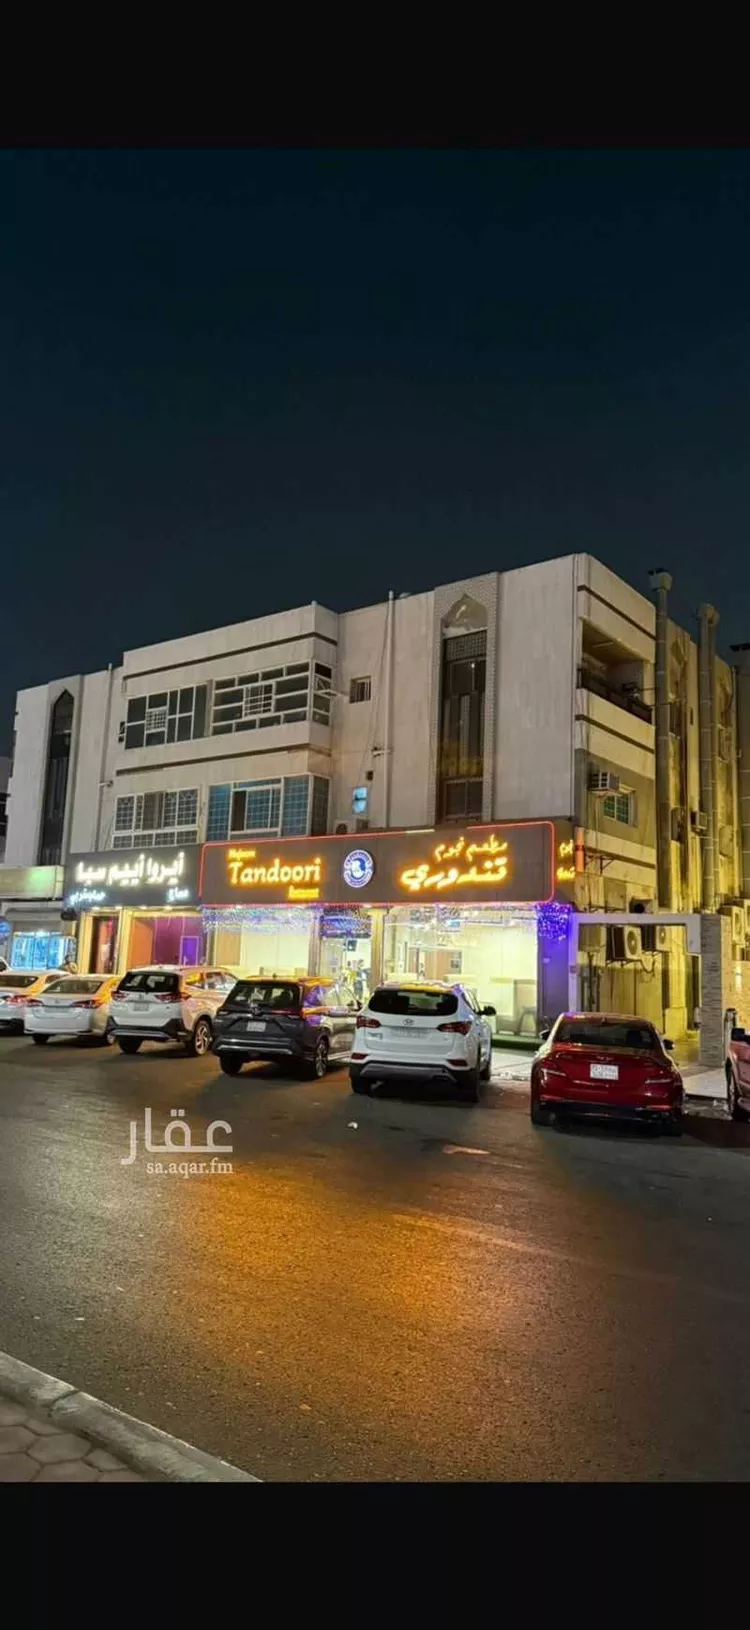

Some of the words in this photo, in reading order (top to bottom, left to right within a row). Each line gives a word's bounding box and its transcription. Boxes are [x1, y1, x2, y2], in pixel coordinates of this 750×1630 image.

[433, 836, 465, 863] نجوم
[466, 834, 508, 863] مطعم
[75, 860, 106, 887] سبا
[227, 856, 322, 885] Tandoori
[401, 856, 508, 889] تندوري
